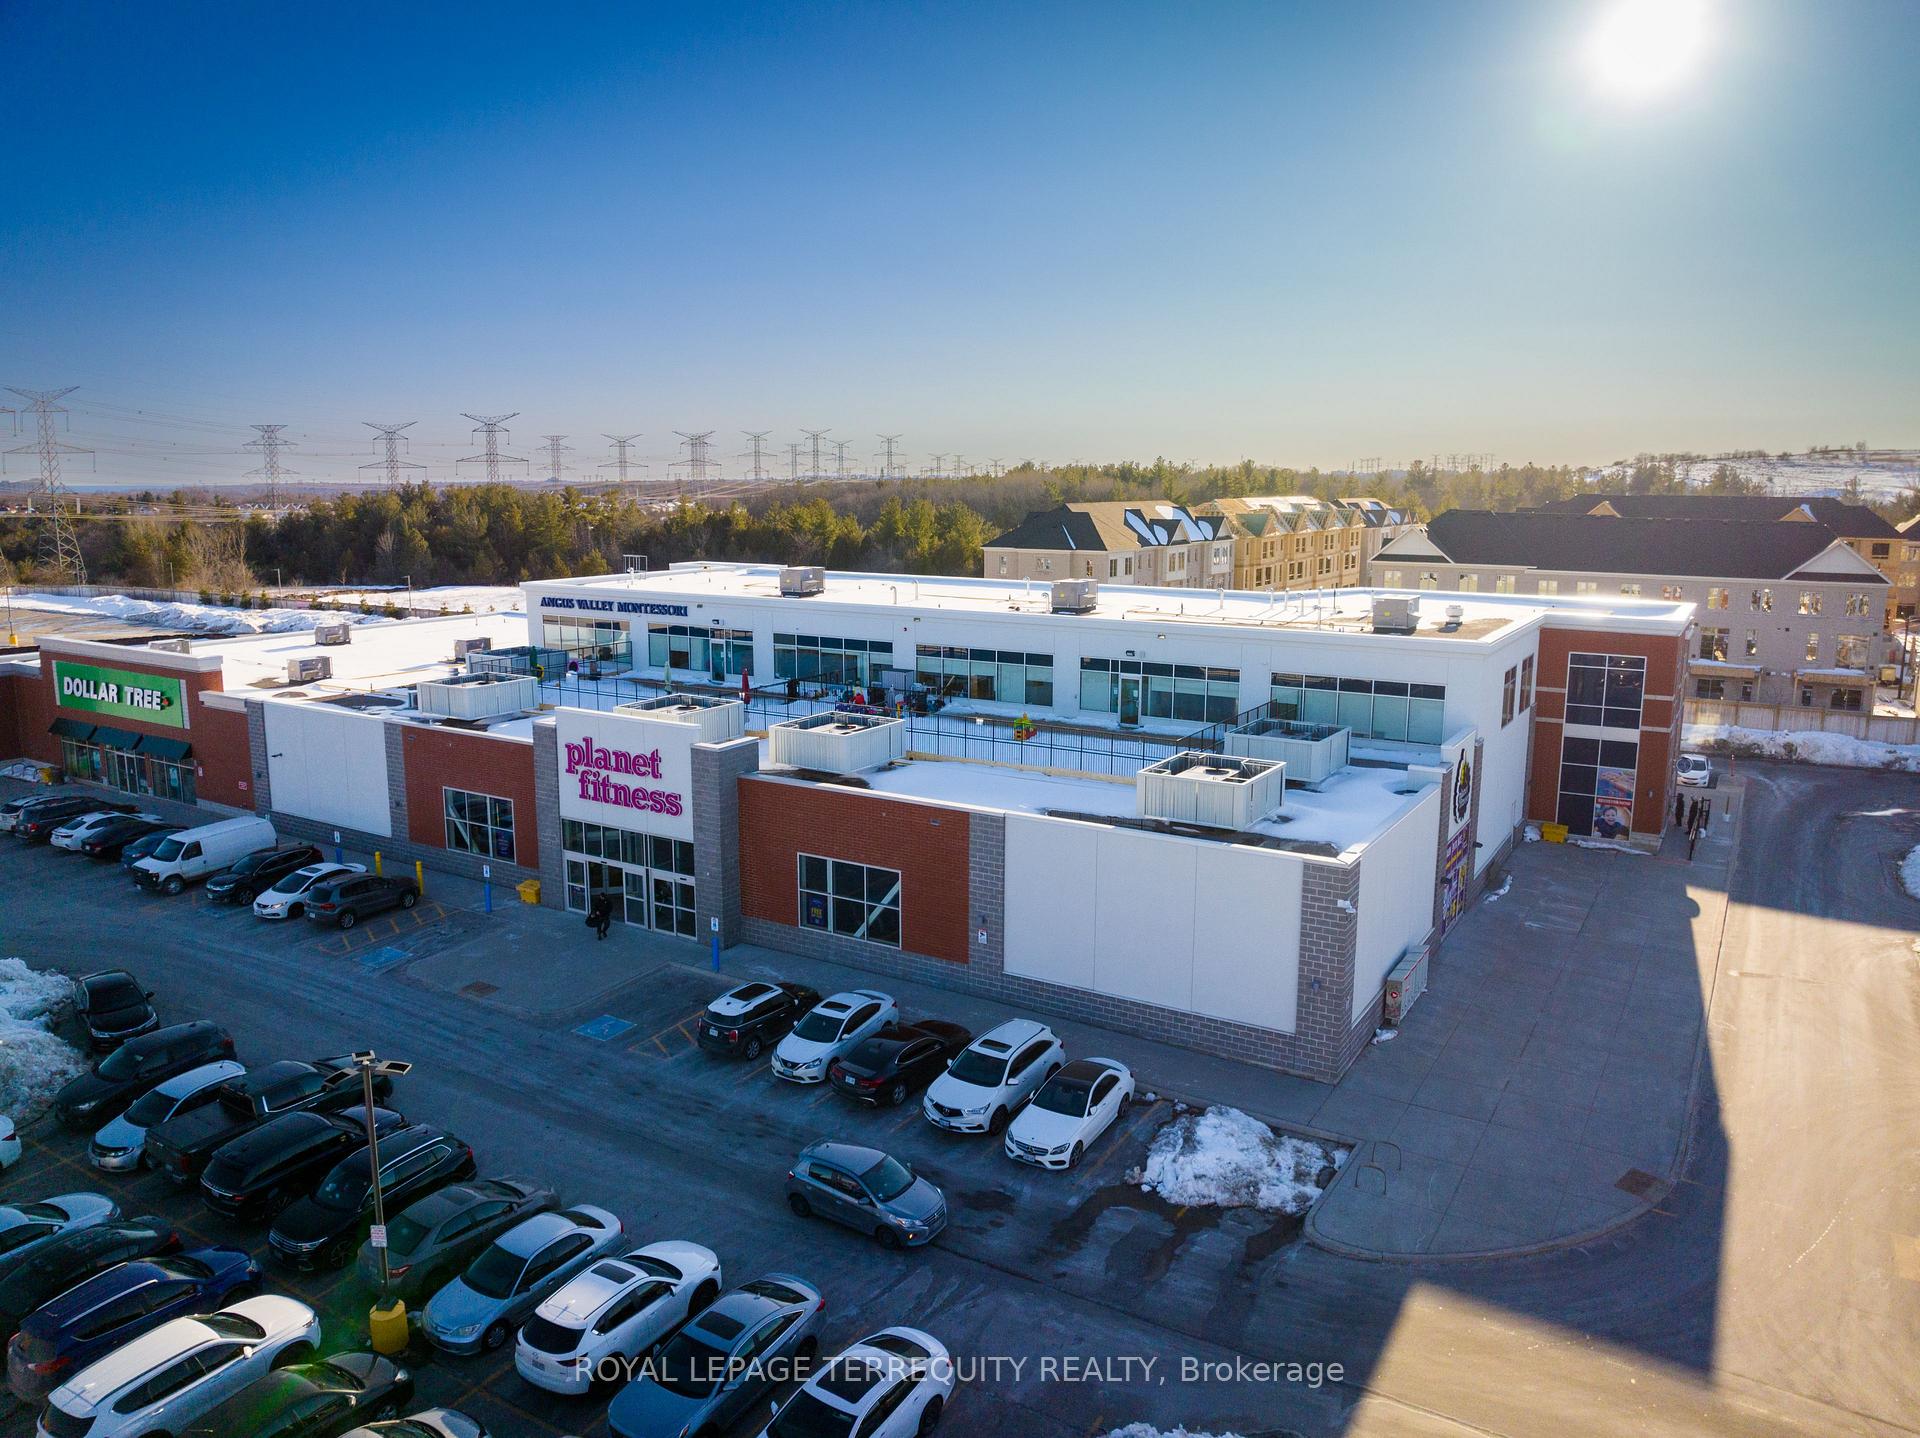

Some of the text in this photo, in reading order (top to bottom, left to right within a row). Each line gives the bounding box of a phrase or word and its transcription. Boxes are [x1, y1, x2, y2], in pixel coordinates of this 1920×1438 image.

[540, 596, 689, 617] ANGUS VALLEY MONTESSORI
[63, 676, 161, 711] DOLLAR TREE
[565, 736, 662, 779] planet
[578, 769, 683, 817] fitness
